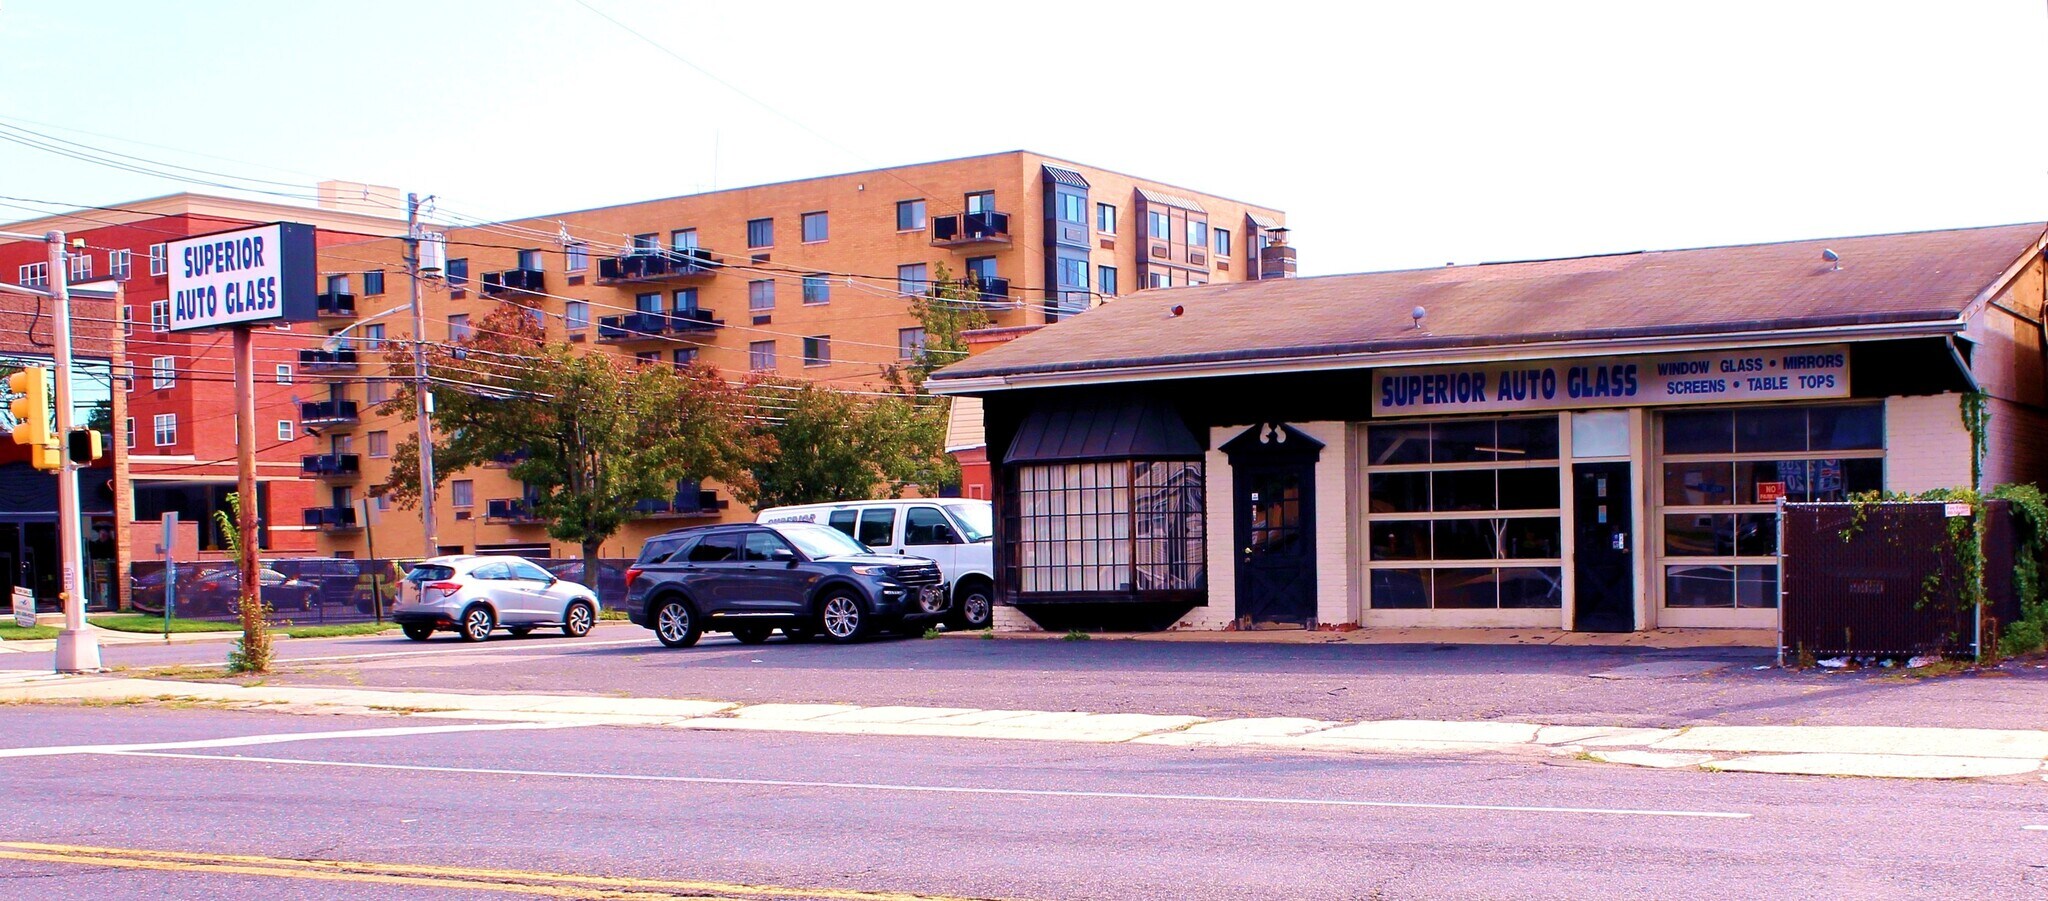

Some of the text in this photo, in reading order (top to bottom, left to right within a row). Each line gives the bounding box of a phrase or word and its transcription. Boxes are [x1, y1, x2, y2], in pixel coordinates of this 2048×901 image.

[184, 236, 265, 278] SUPERIOR
[176, 276, 276, 321] AUTO GLASS
[1657, 354, 1844, 376] WINDOW GLASS MIRRORS
[1381, 364, 1638, 407] SUPERIOR AUTO GLASS
[1667, 374, 1835, 395] SCREENS TABLE TOPS
[1765, 485, 1777, 493] NO
